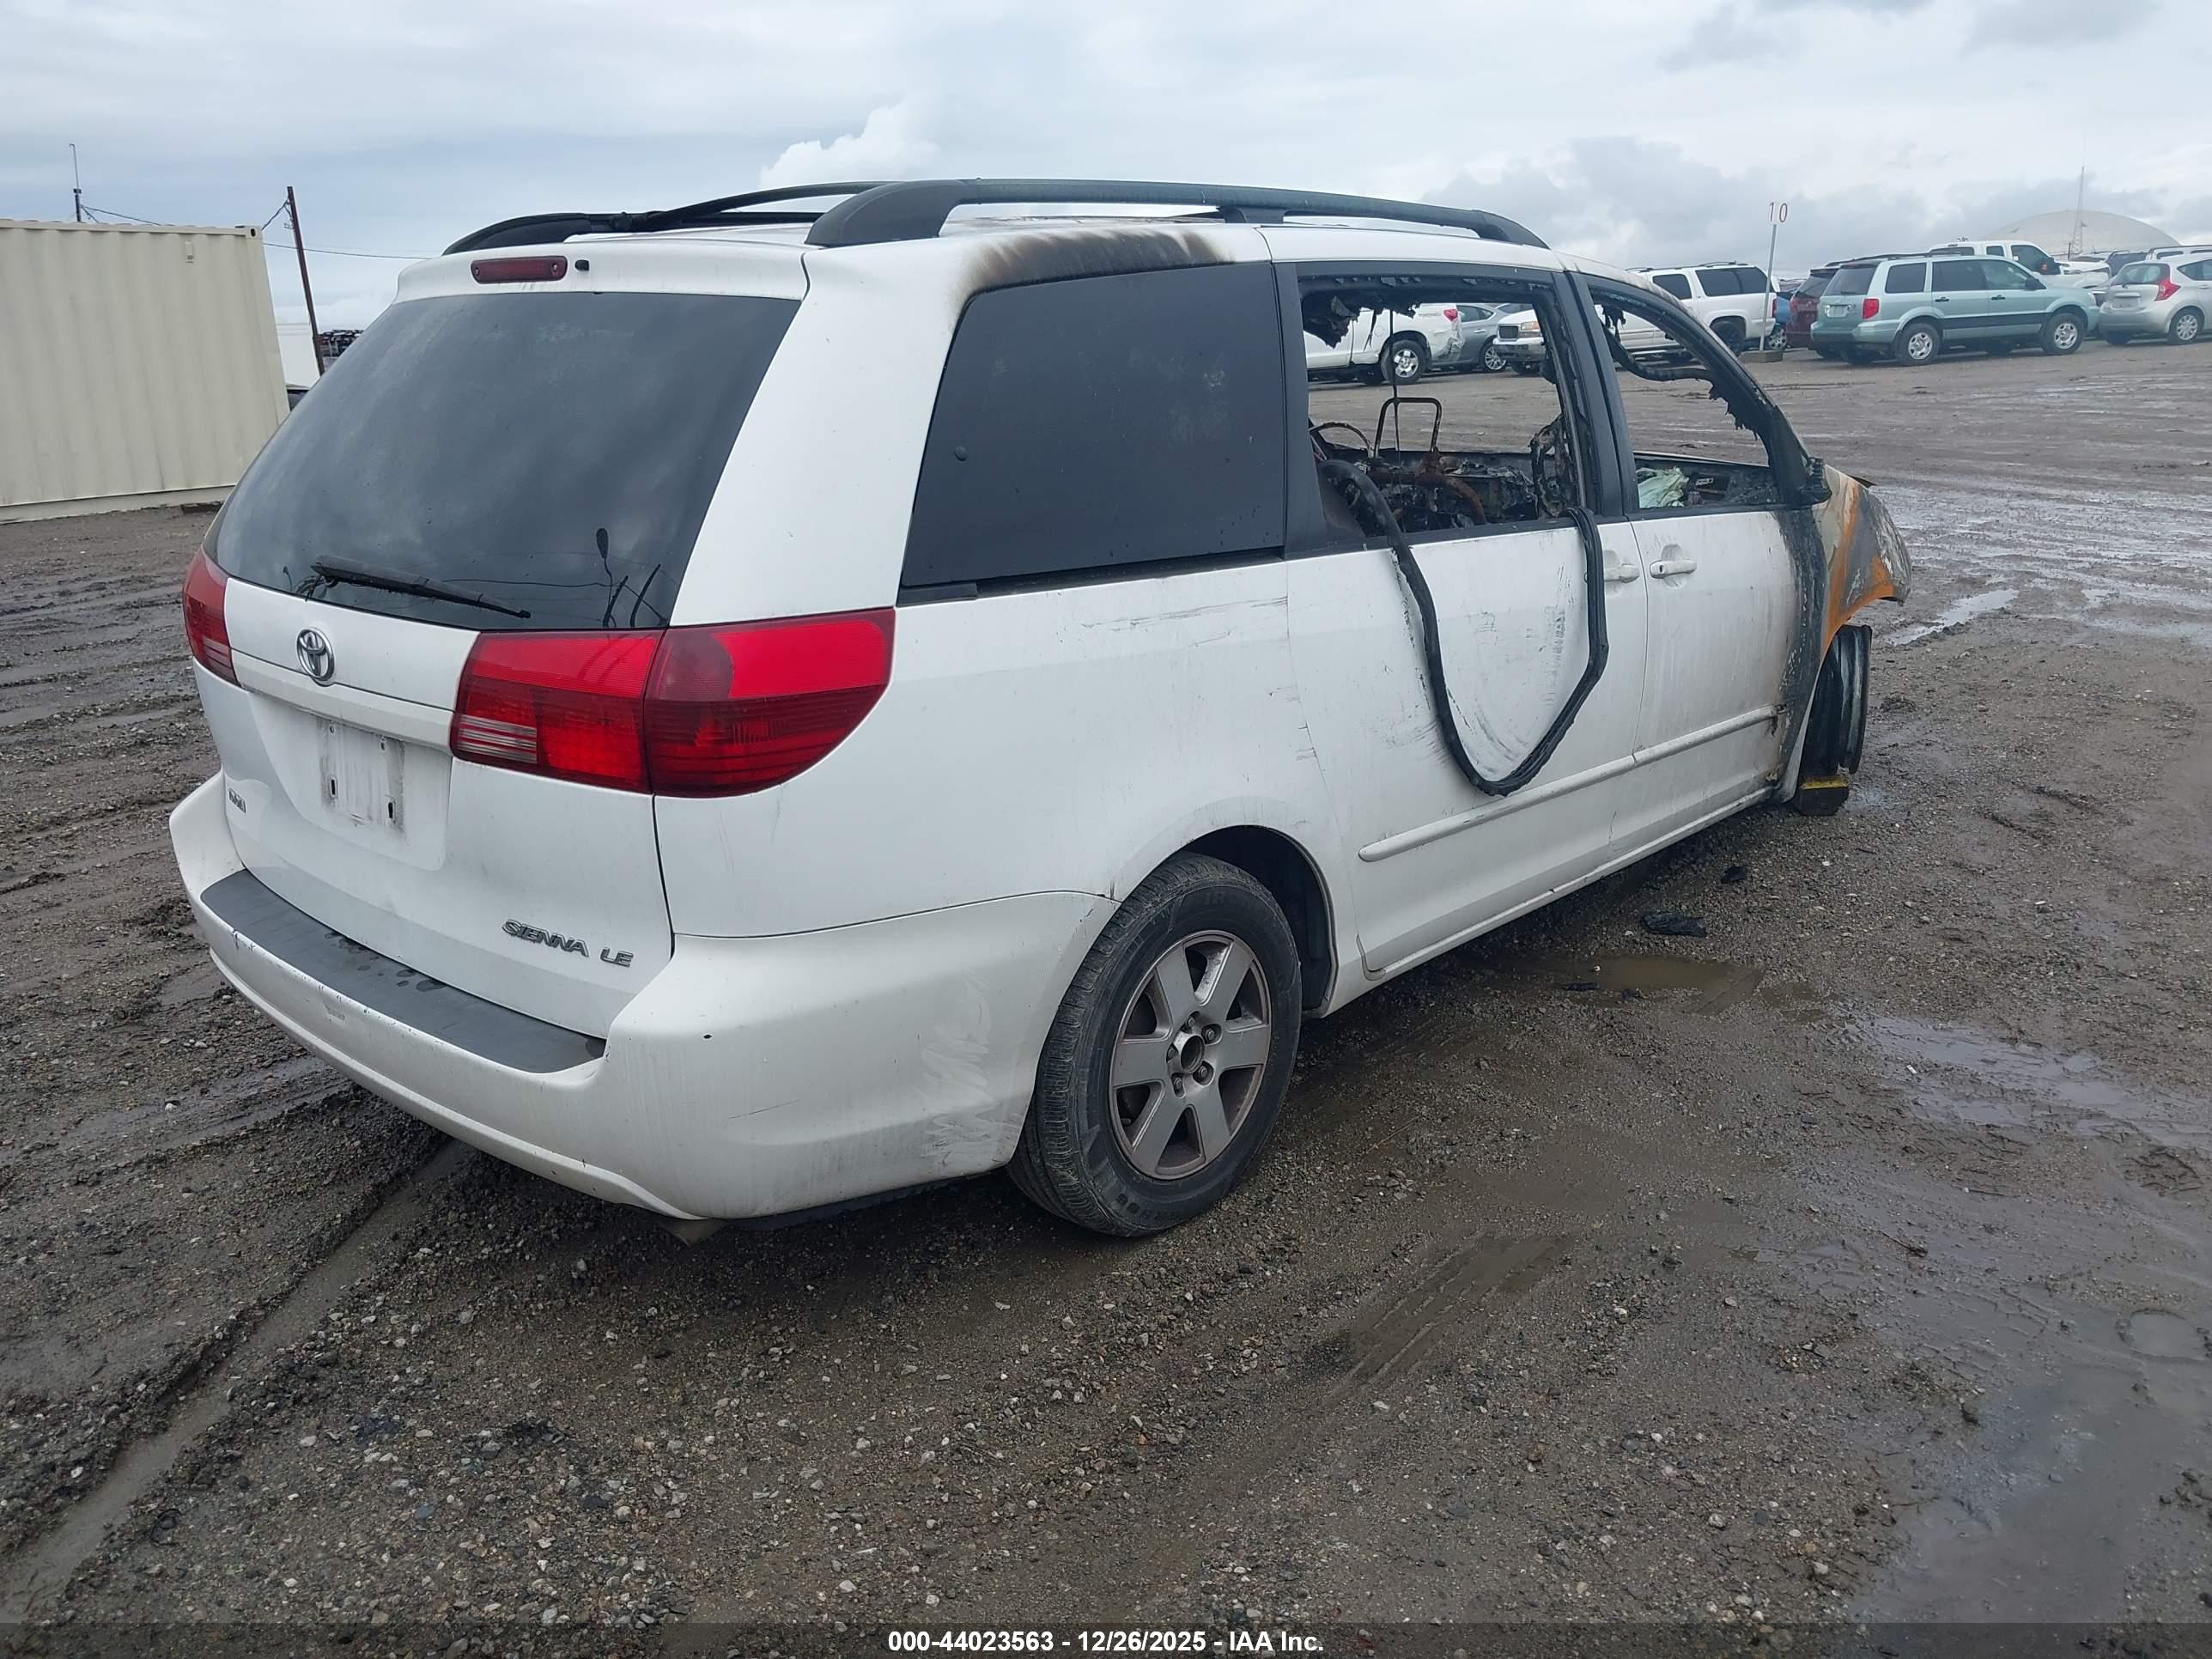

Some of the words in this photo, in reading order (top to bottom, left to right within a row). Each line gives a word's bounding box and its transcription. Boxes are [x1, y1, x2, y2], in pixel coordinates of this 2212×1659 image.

[1769, 202, 1788, 222] 10
[501, 919, 590, 958] SIENNA
[599, 946, 635, 968] LE
